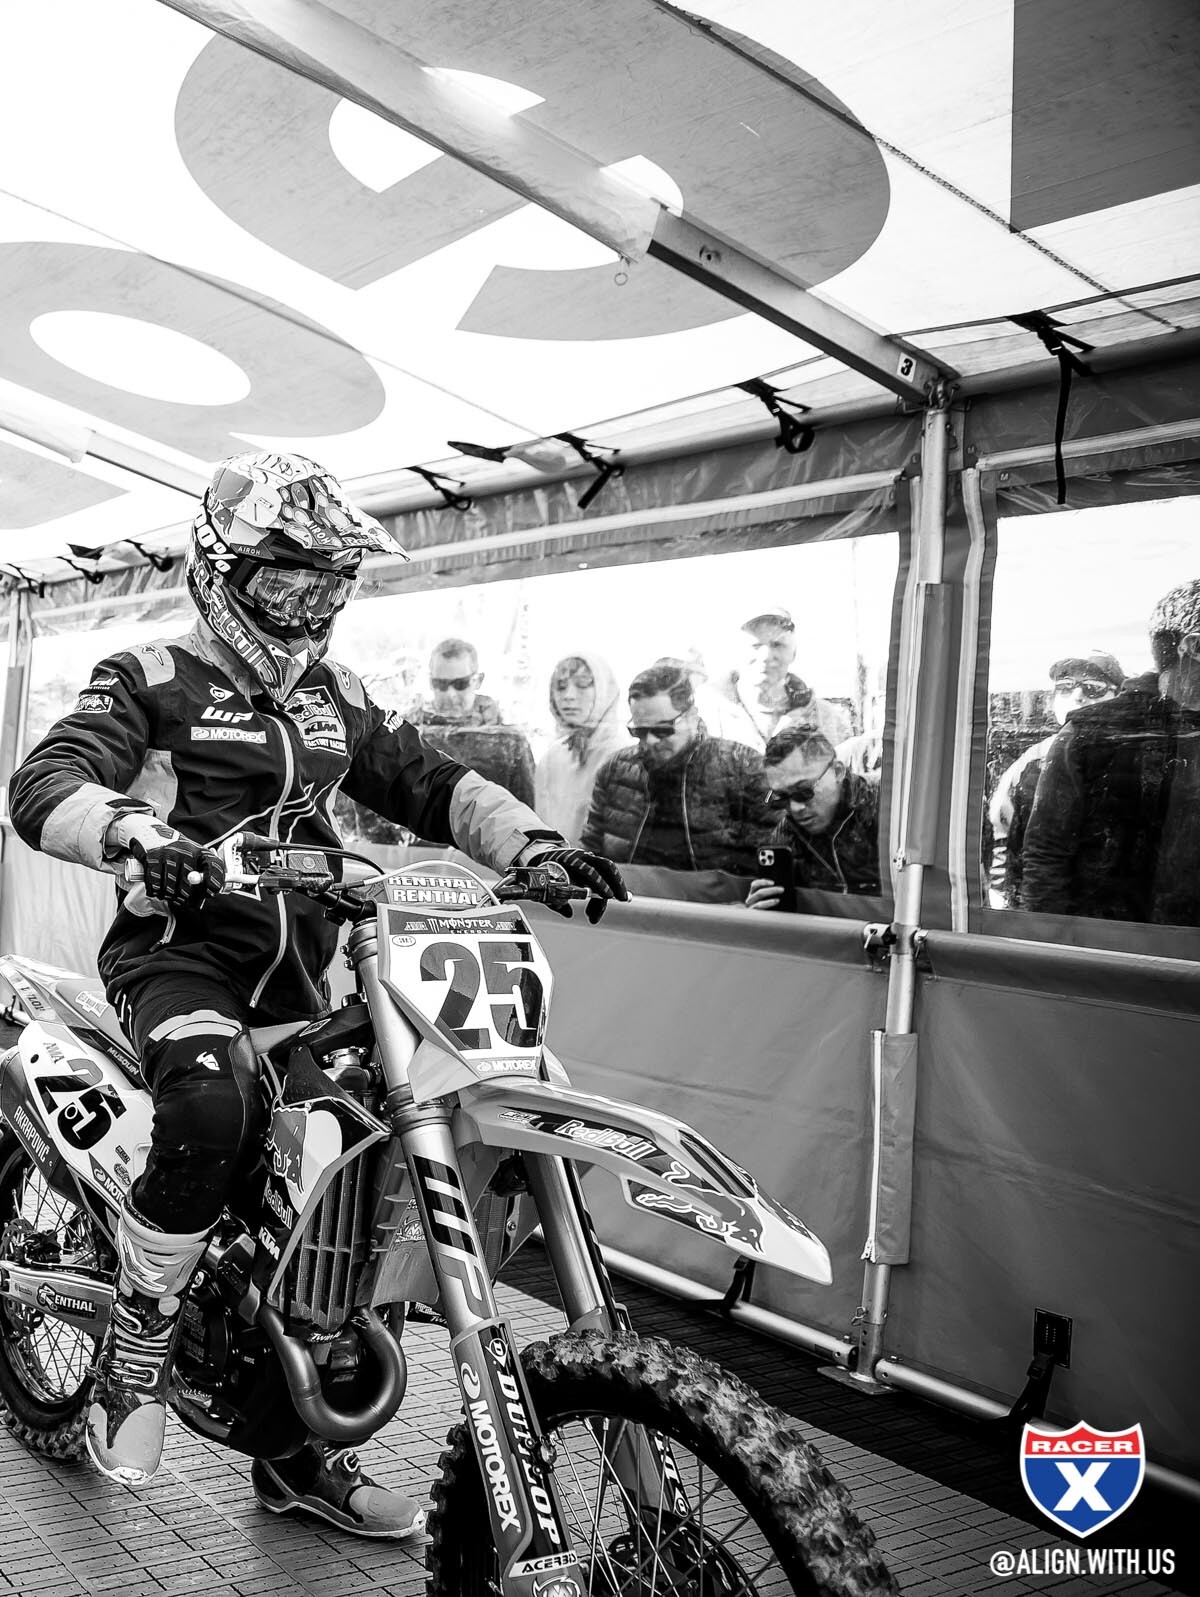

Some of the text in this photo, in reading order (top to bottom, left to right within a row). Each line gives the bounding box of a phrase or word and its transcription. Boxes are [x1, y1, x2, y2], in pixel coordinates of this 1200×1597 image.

[901, 358, 913, 376] 3
[305, 520, 332, 545] AIROH
[238, 546, 261, 556] AIROH
[201, 706, 254, 723] WP
[210, 728, 266, 743] MOTOREX
[304, 721, 338, 735] KTM
[393, 889, 478, 905] RENTHAL
[439, 917, 494, 929] MONSTER
[420, 942, 543, 1051] 25
[107, 1047, 140, 1075] MUSQUIN
[493, 1059, 537, 1071] MOTOREX
[34, 1058, 127, 1150] 25
[258, 1226, 280, 1261] KTM
[470, 1401, 521, 1534] MOTOREX
